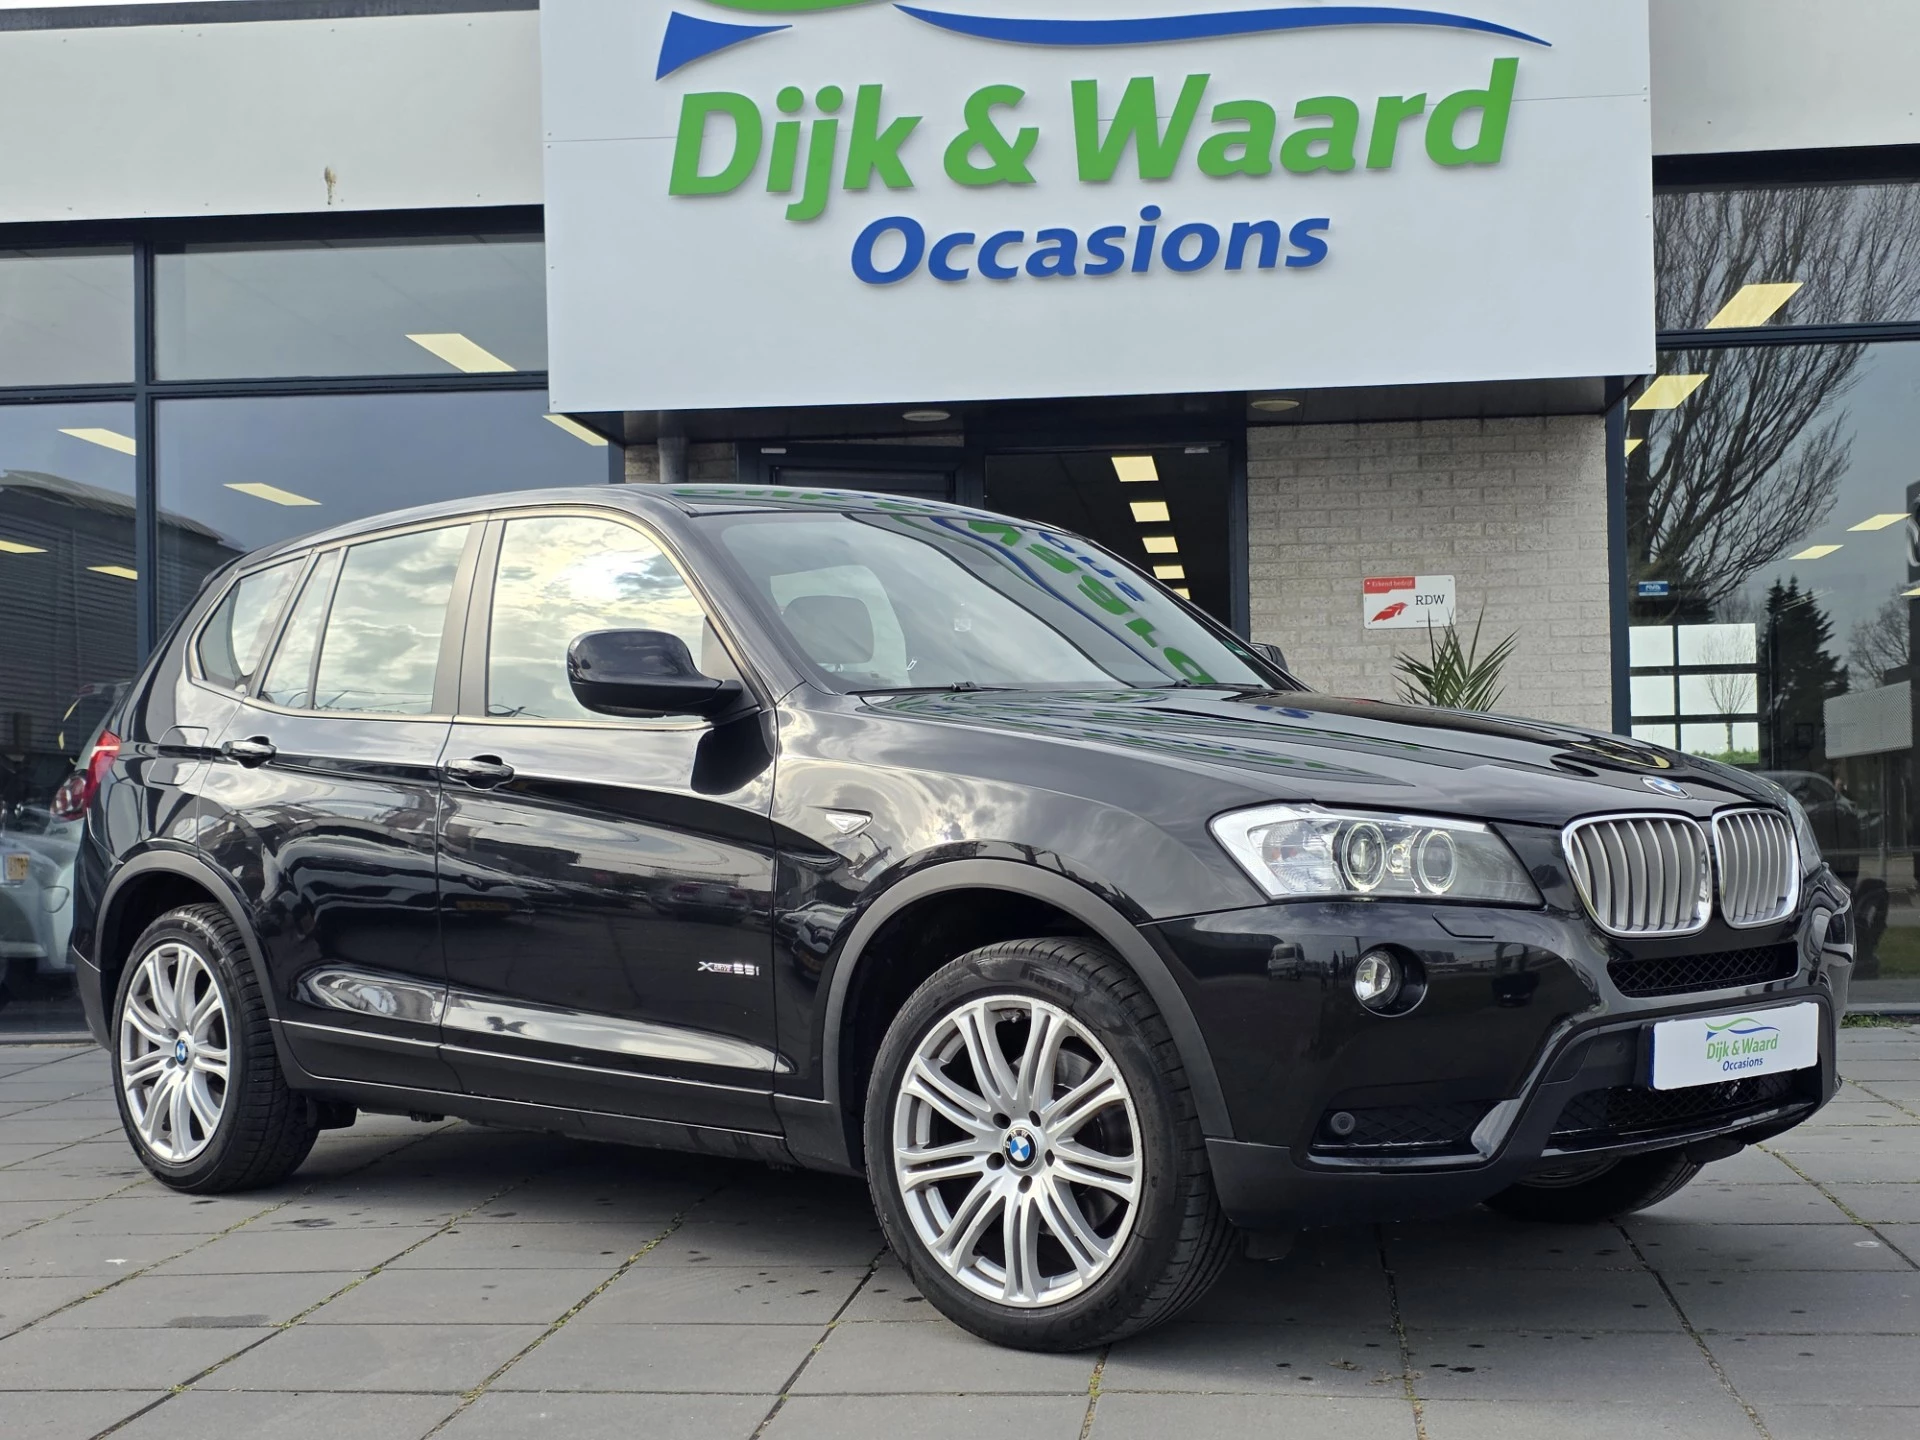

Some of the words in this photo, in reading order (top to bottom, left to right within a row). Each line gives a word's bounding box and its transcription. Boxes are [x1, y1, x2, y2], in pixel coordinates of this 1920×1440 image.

[669, 84, 924, 221] Dijk
[943, 84, 1040, 186] &
[1070, 57, 1519, 182] Waard
[851, 204, 1330, 285] Occasions
[1415, 594, 1445, 606] RDW
[1706, 1041, 1730, 1062] Dijk
[1731, 1040, 1740, 1056] &
[1742, 1034, 1779, 1054] Waard
[1722, 1057, 1764, 1072] Occasions
